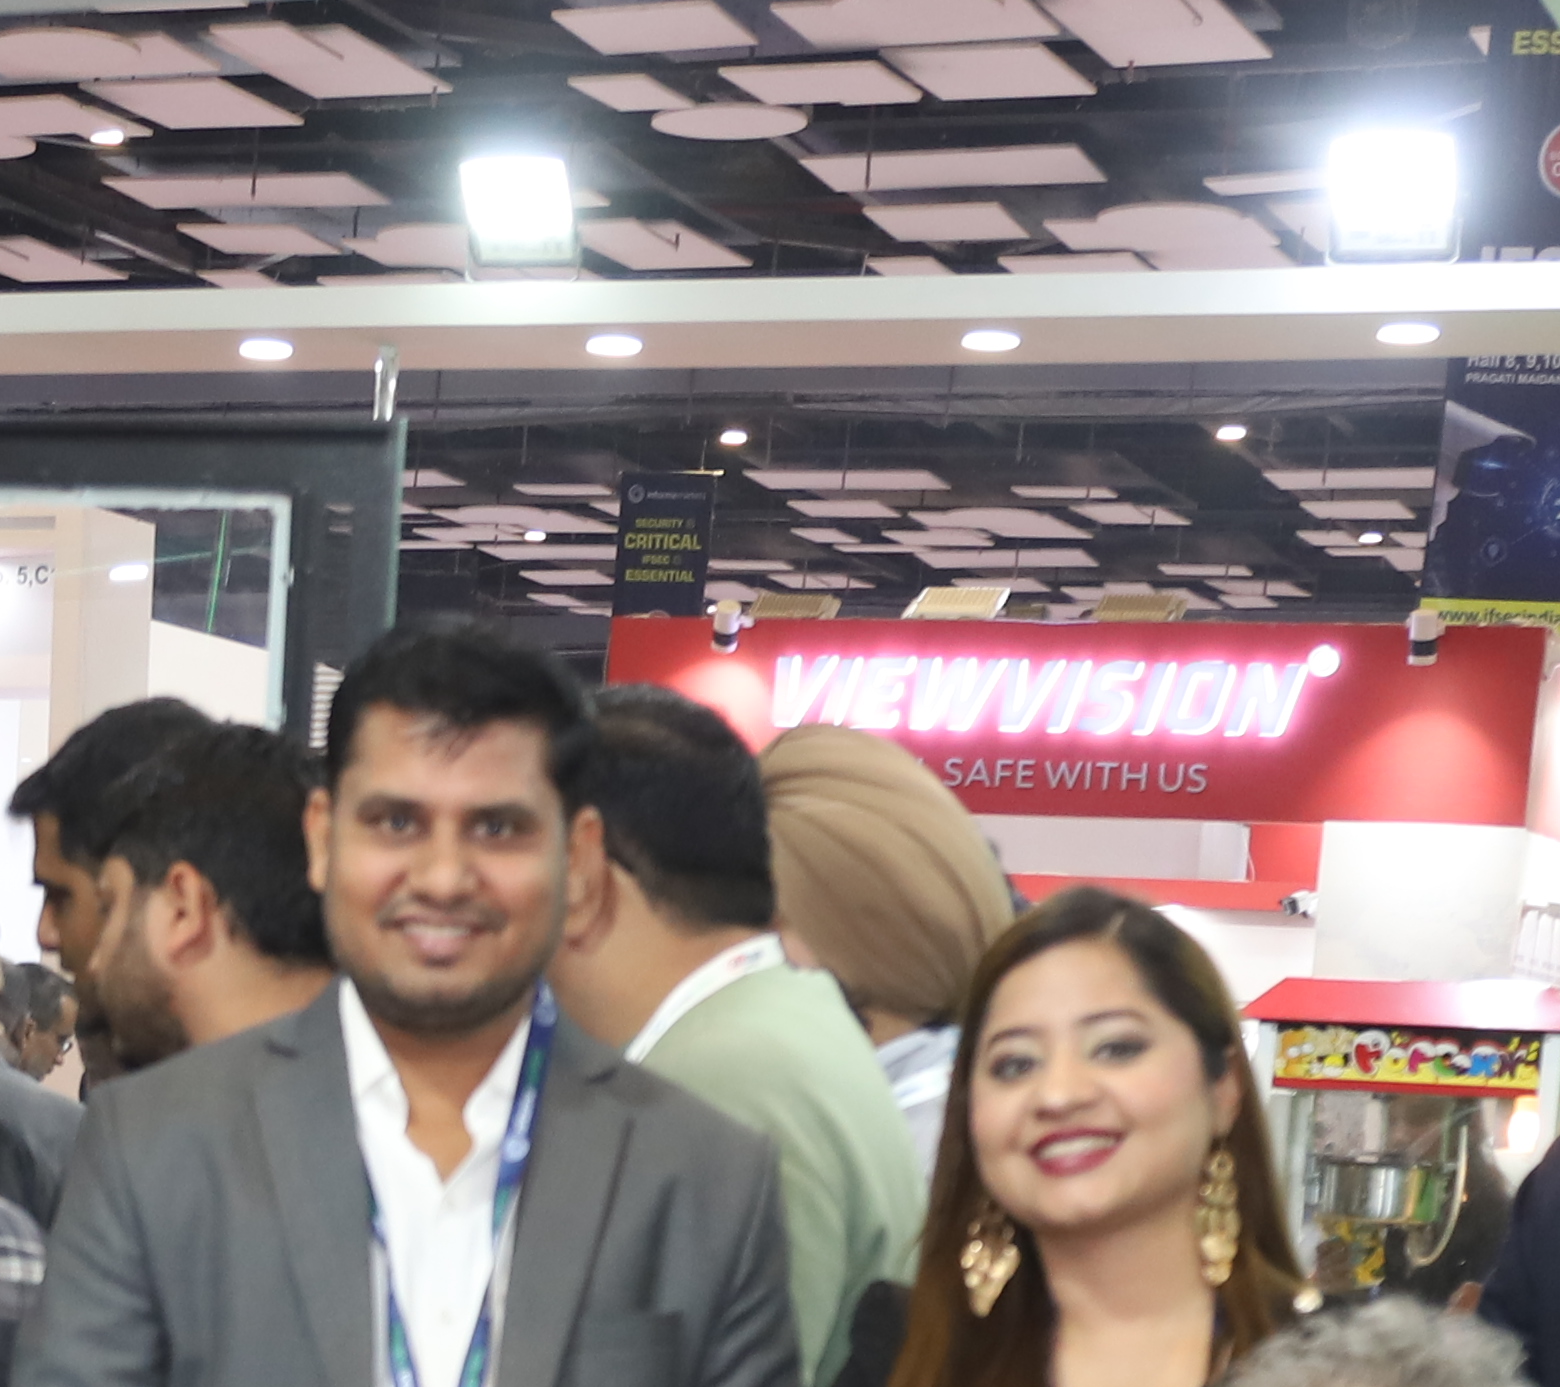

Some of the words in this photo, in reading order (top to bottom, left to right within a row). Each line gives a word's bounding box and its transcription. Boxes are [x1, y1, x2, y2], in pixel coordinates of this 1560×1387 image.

[1465, 372, 1516, 384] PRAGATI
[624, 533, 702, 550] CRITICAL
[16, 564, 55, 588] 5,C
[624, 569, 695, 582] ESSENTIAL
[771, 654, 1309, 738] VIEWVISION
[942, 758, 1036, 789] SAFE
[1043, 760, 1149, 792] WITH
[1157, 762, 1209, 793] US
